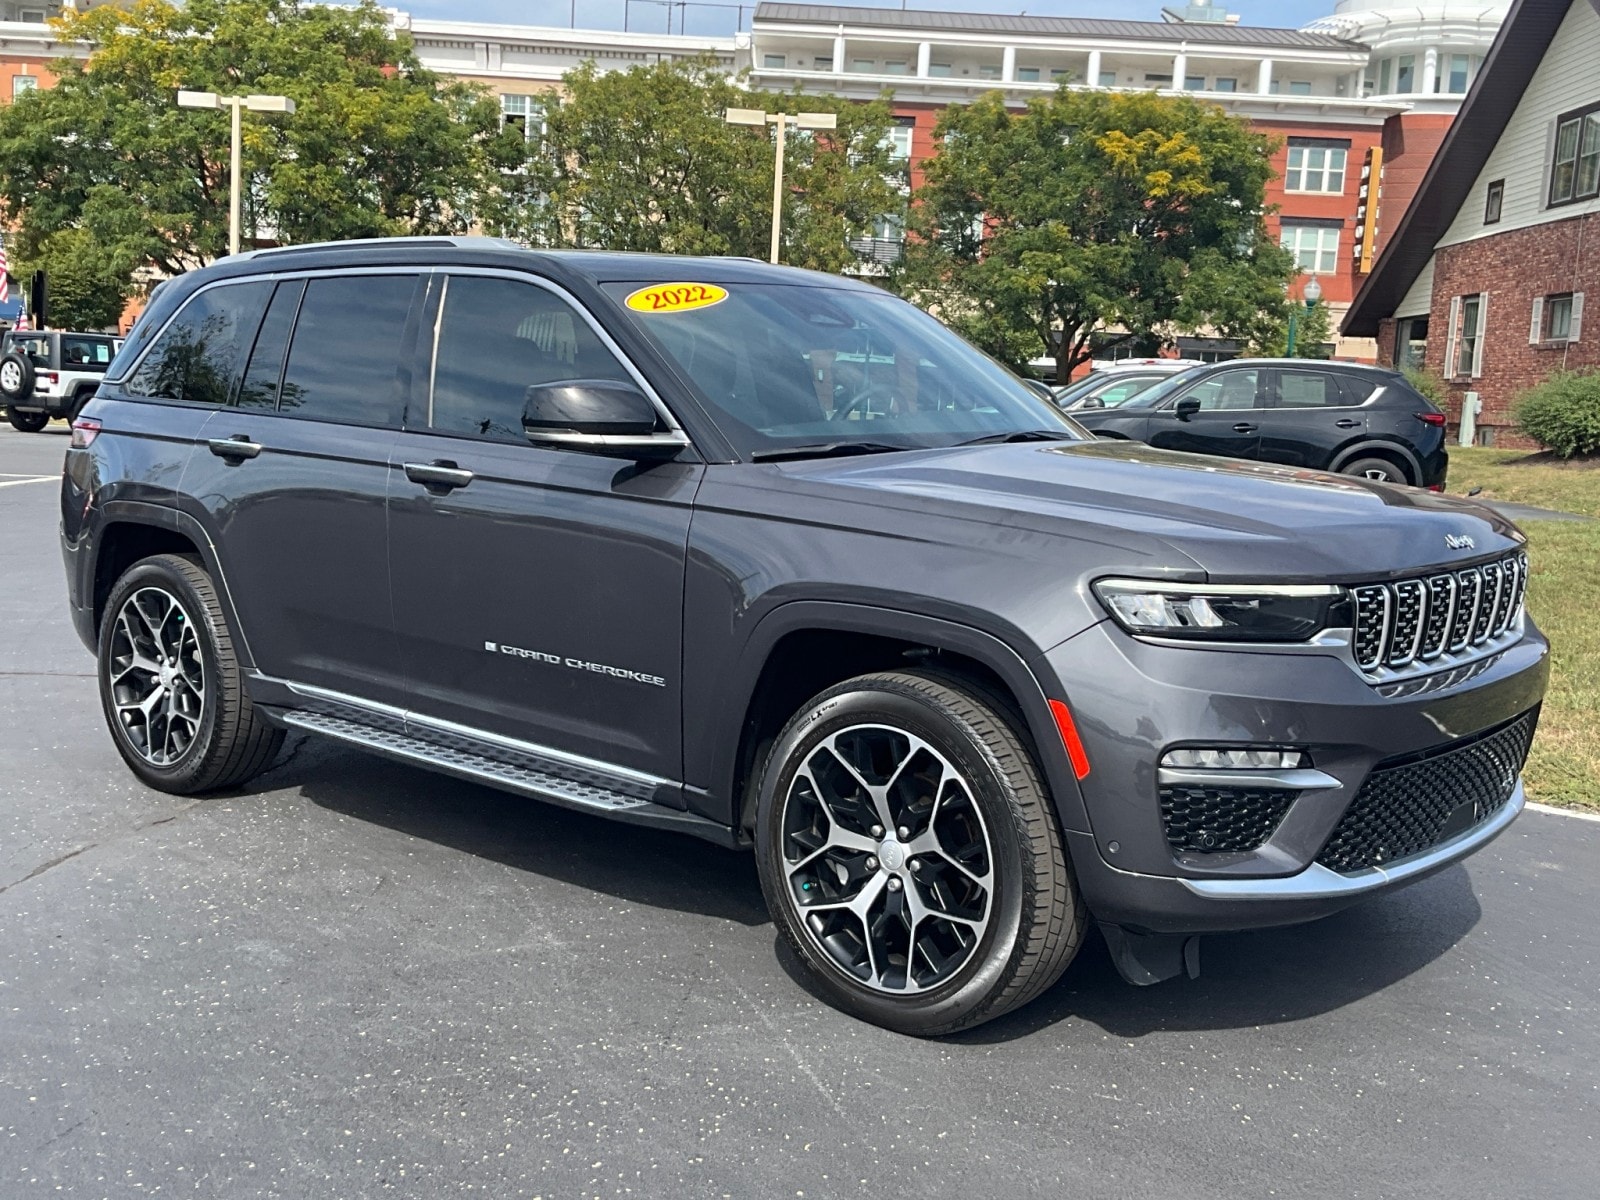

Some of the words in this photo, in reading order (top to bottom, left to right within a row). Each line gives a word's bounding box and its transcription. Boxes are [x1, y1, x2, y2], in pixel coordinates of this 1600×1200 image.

[645, 286, 712, 309] 2022
[1444, 533, 1475, 550] Jeep
[500, 644, 560, 664] GRAND
[565, 658, 666, 687] CHEROKEE
